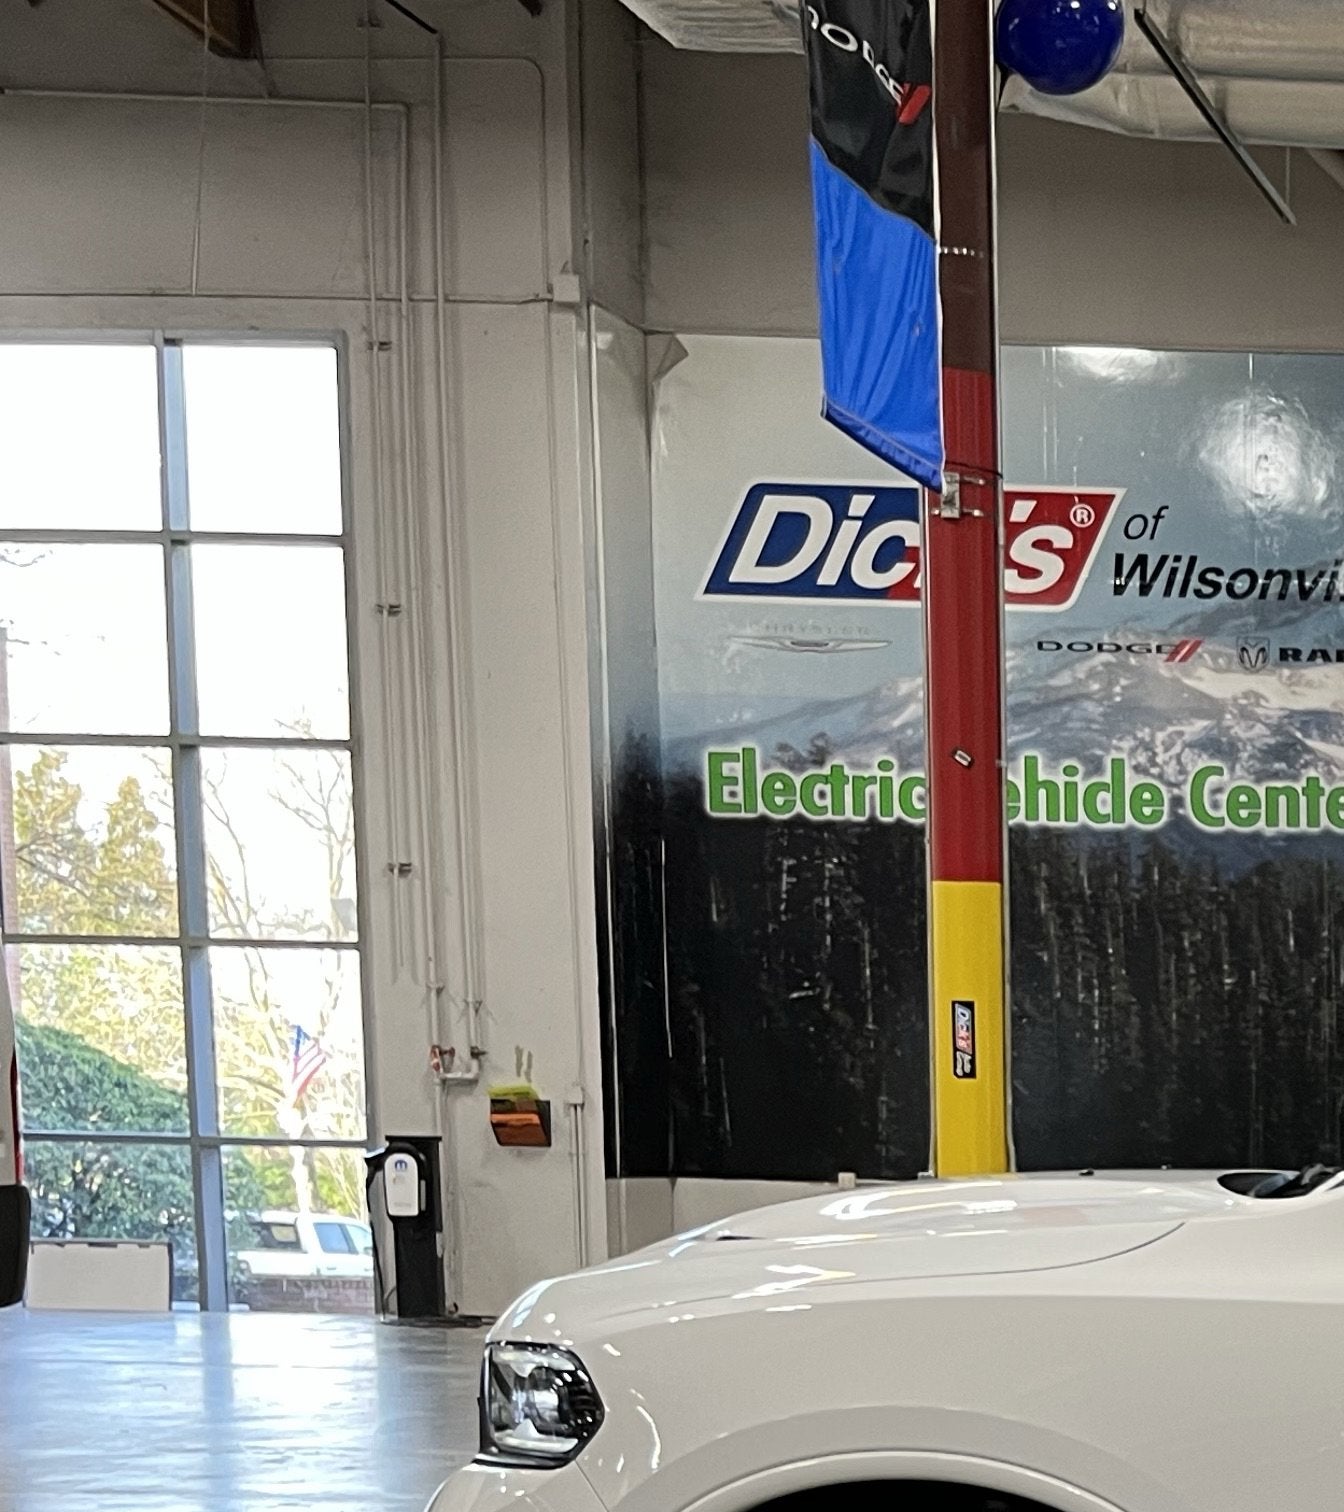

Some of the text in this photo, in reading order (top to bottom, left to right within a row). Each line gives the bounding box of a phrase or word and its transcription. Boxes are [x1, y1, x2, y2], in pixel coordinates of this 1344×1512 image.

[728, 494, 1074, 595] Dic's
[1123, 505, 1169, 540] of
[1036, 639, 1177, 655] DODGE
[707, 746, 926, 819] Electric
[1006, 754, 1165, 825] hicle
